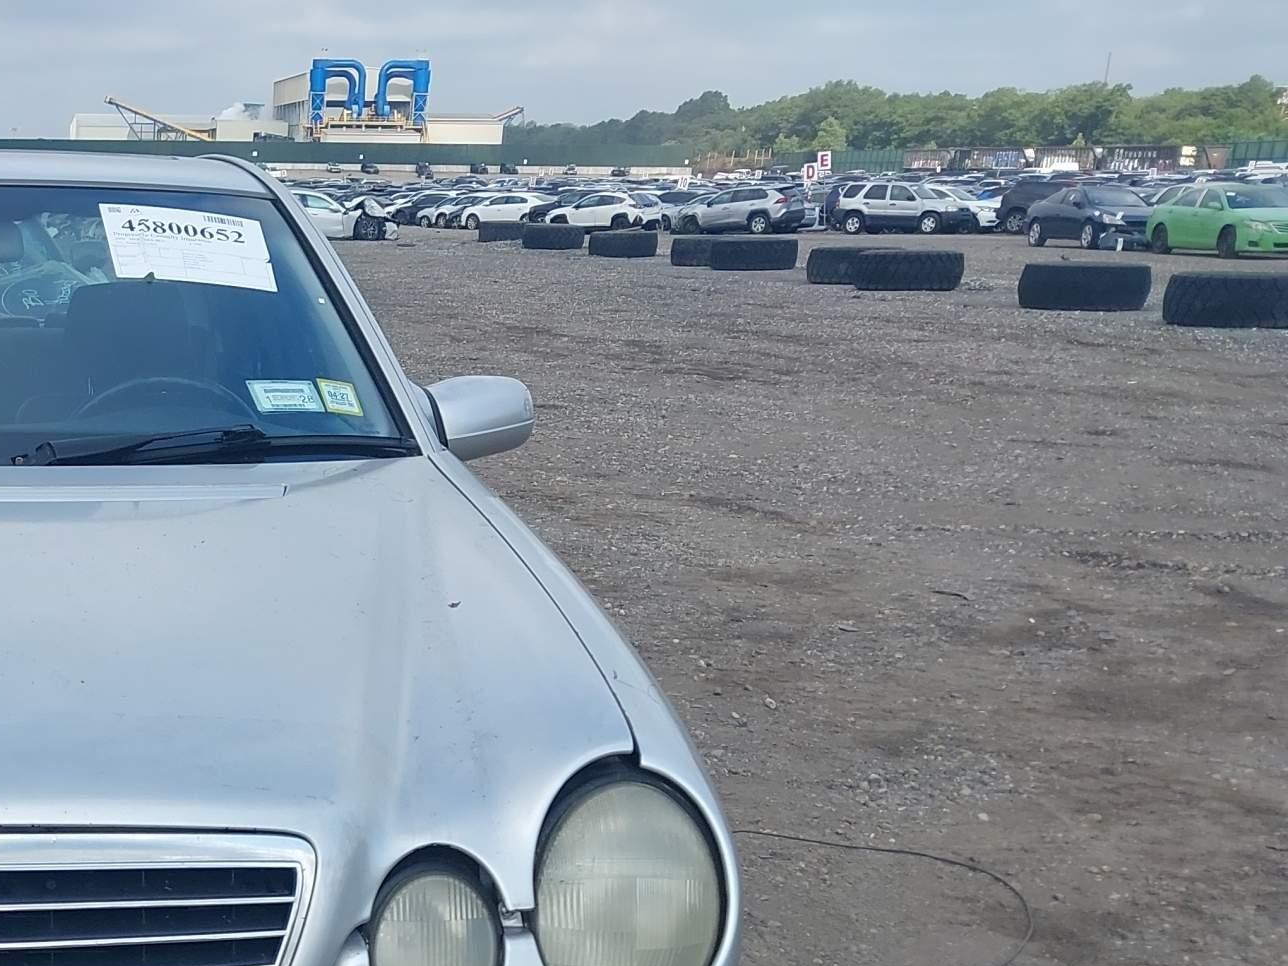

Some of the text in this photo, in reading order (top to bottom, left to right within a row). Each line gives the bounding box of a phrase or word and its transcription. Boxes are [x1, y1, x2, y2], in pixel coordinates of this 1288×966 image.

[820, 154, 829, 168] E
[806, 165, 815, 180] D
[120, 218, 246, 245] 45800652
